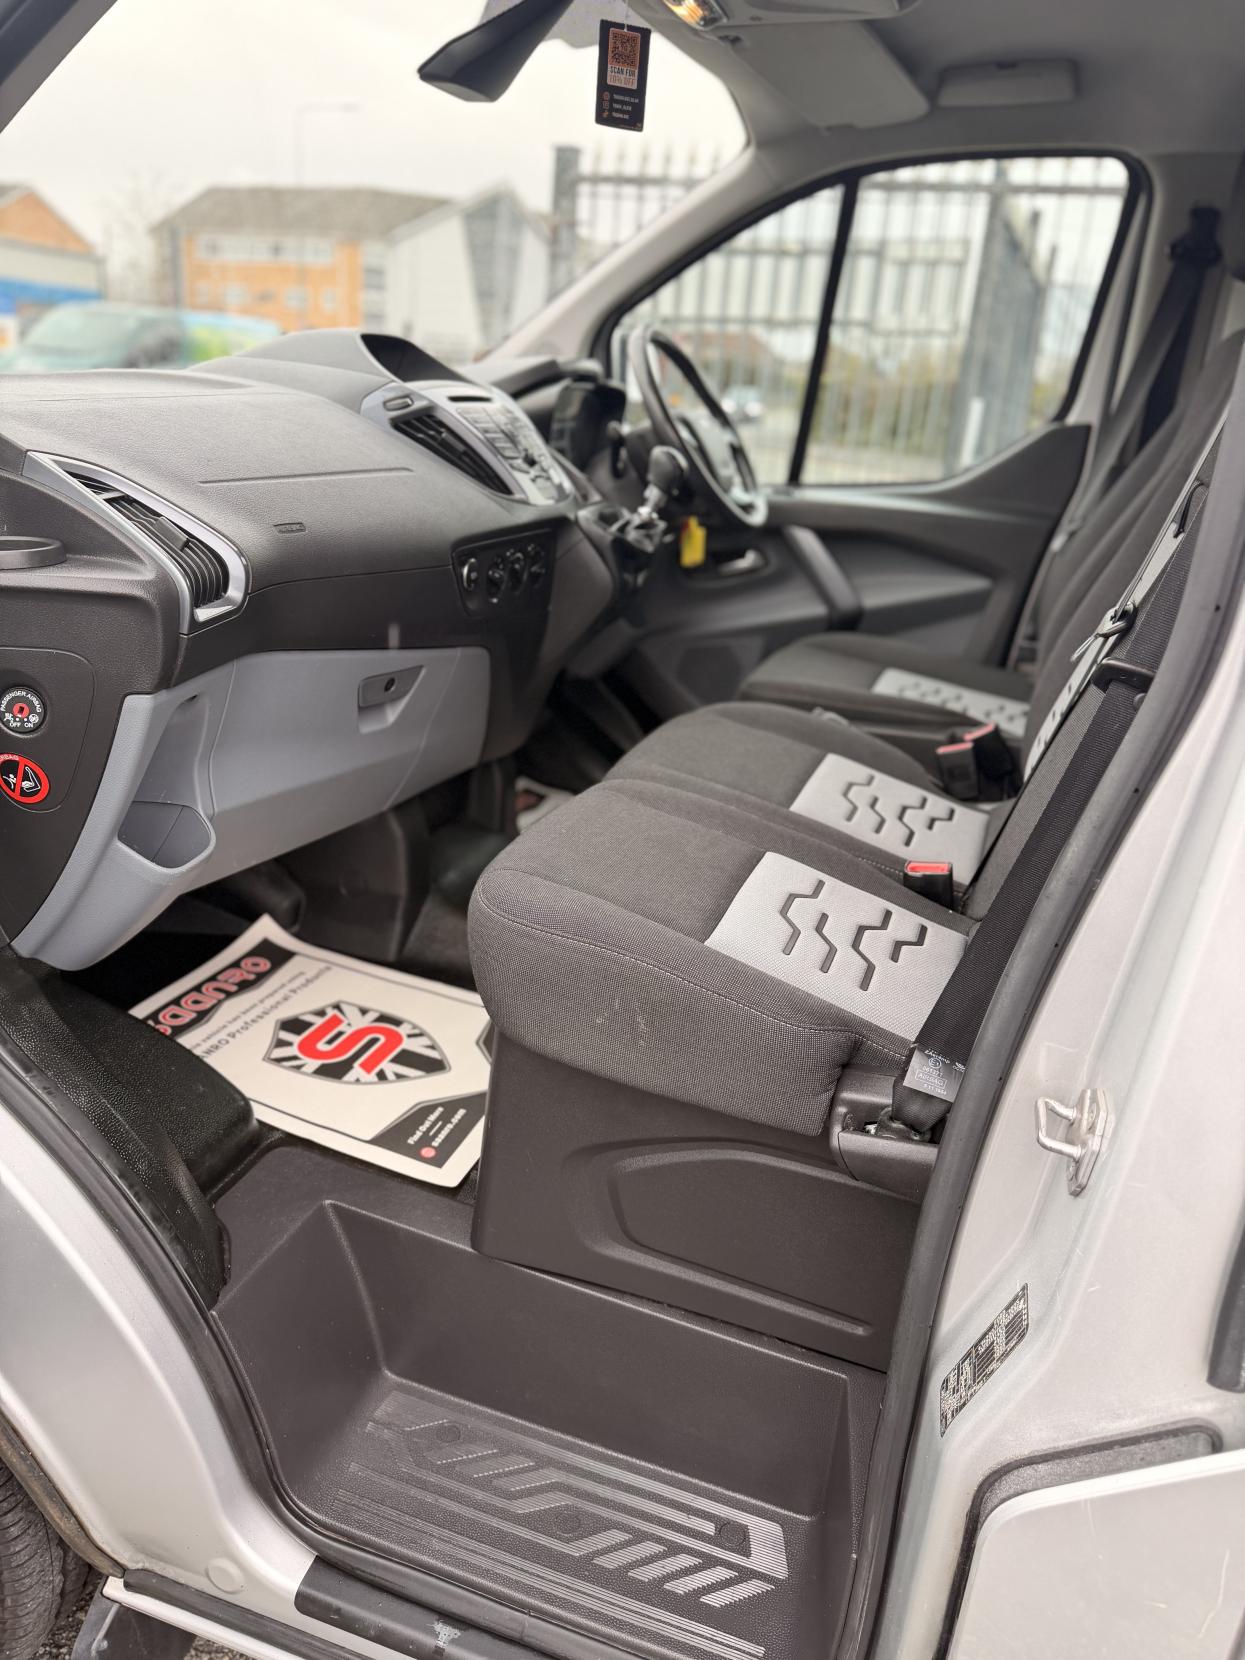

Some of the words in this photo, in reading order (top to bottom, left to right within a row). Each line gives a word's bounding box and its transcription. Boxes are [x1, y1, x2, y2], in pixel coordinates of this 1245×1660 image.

[610, 66, 624, 76] SCAN
[626, 69, 636, 78] FOR
[0, 690, 26, 712] PASSENGER
[27, 694, 42, 713] AIRBAG
[227, 994, 291, 1039] Professional
[407, 1130, 423, 1145] Find
[418, 1119, 432, 1132] Out
[427, 1106, 444, 1123] More
